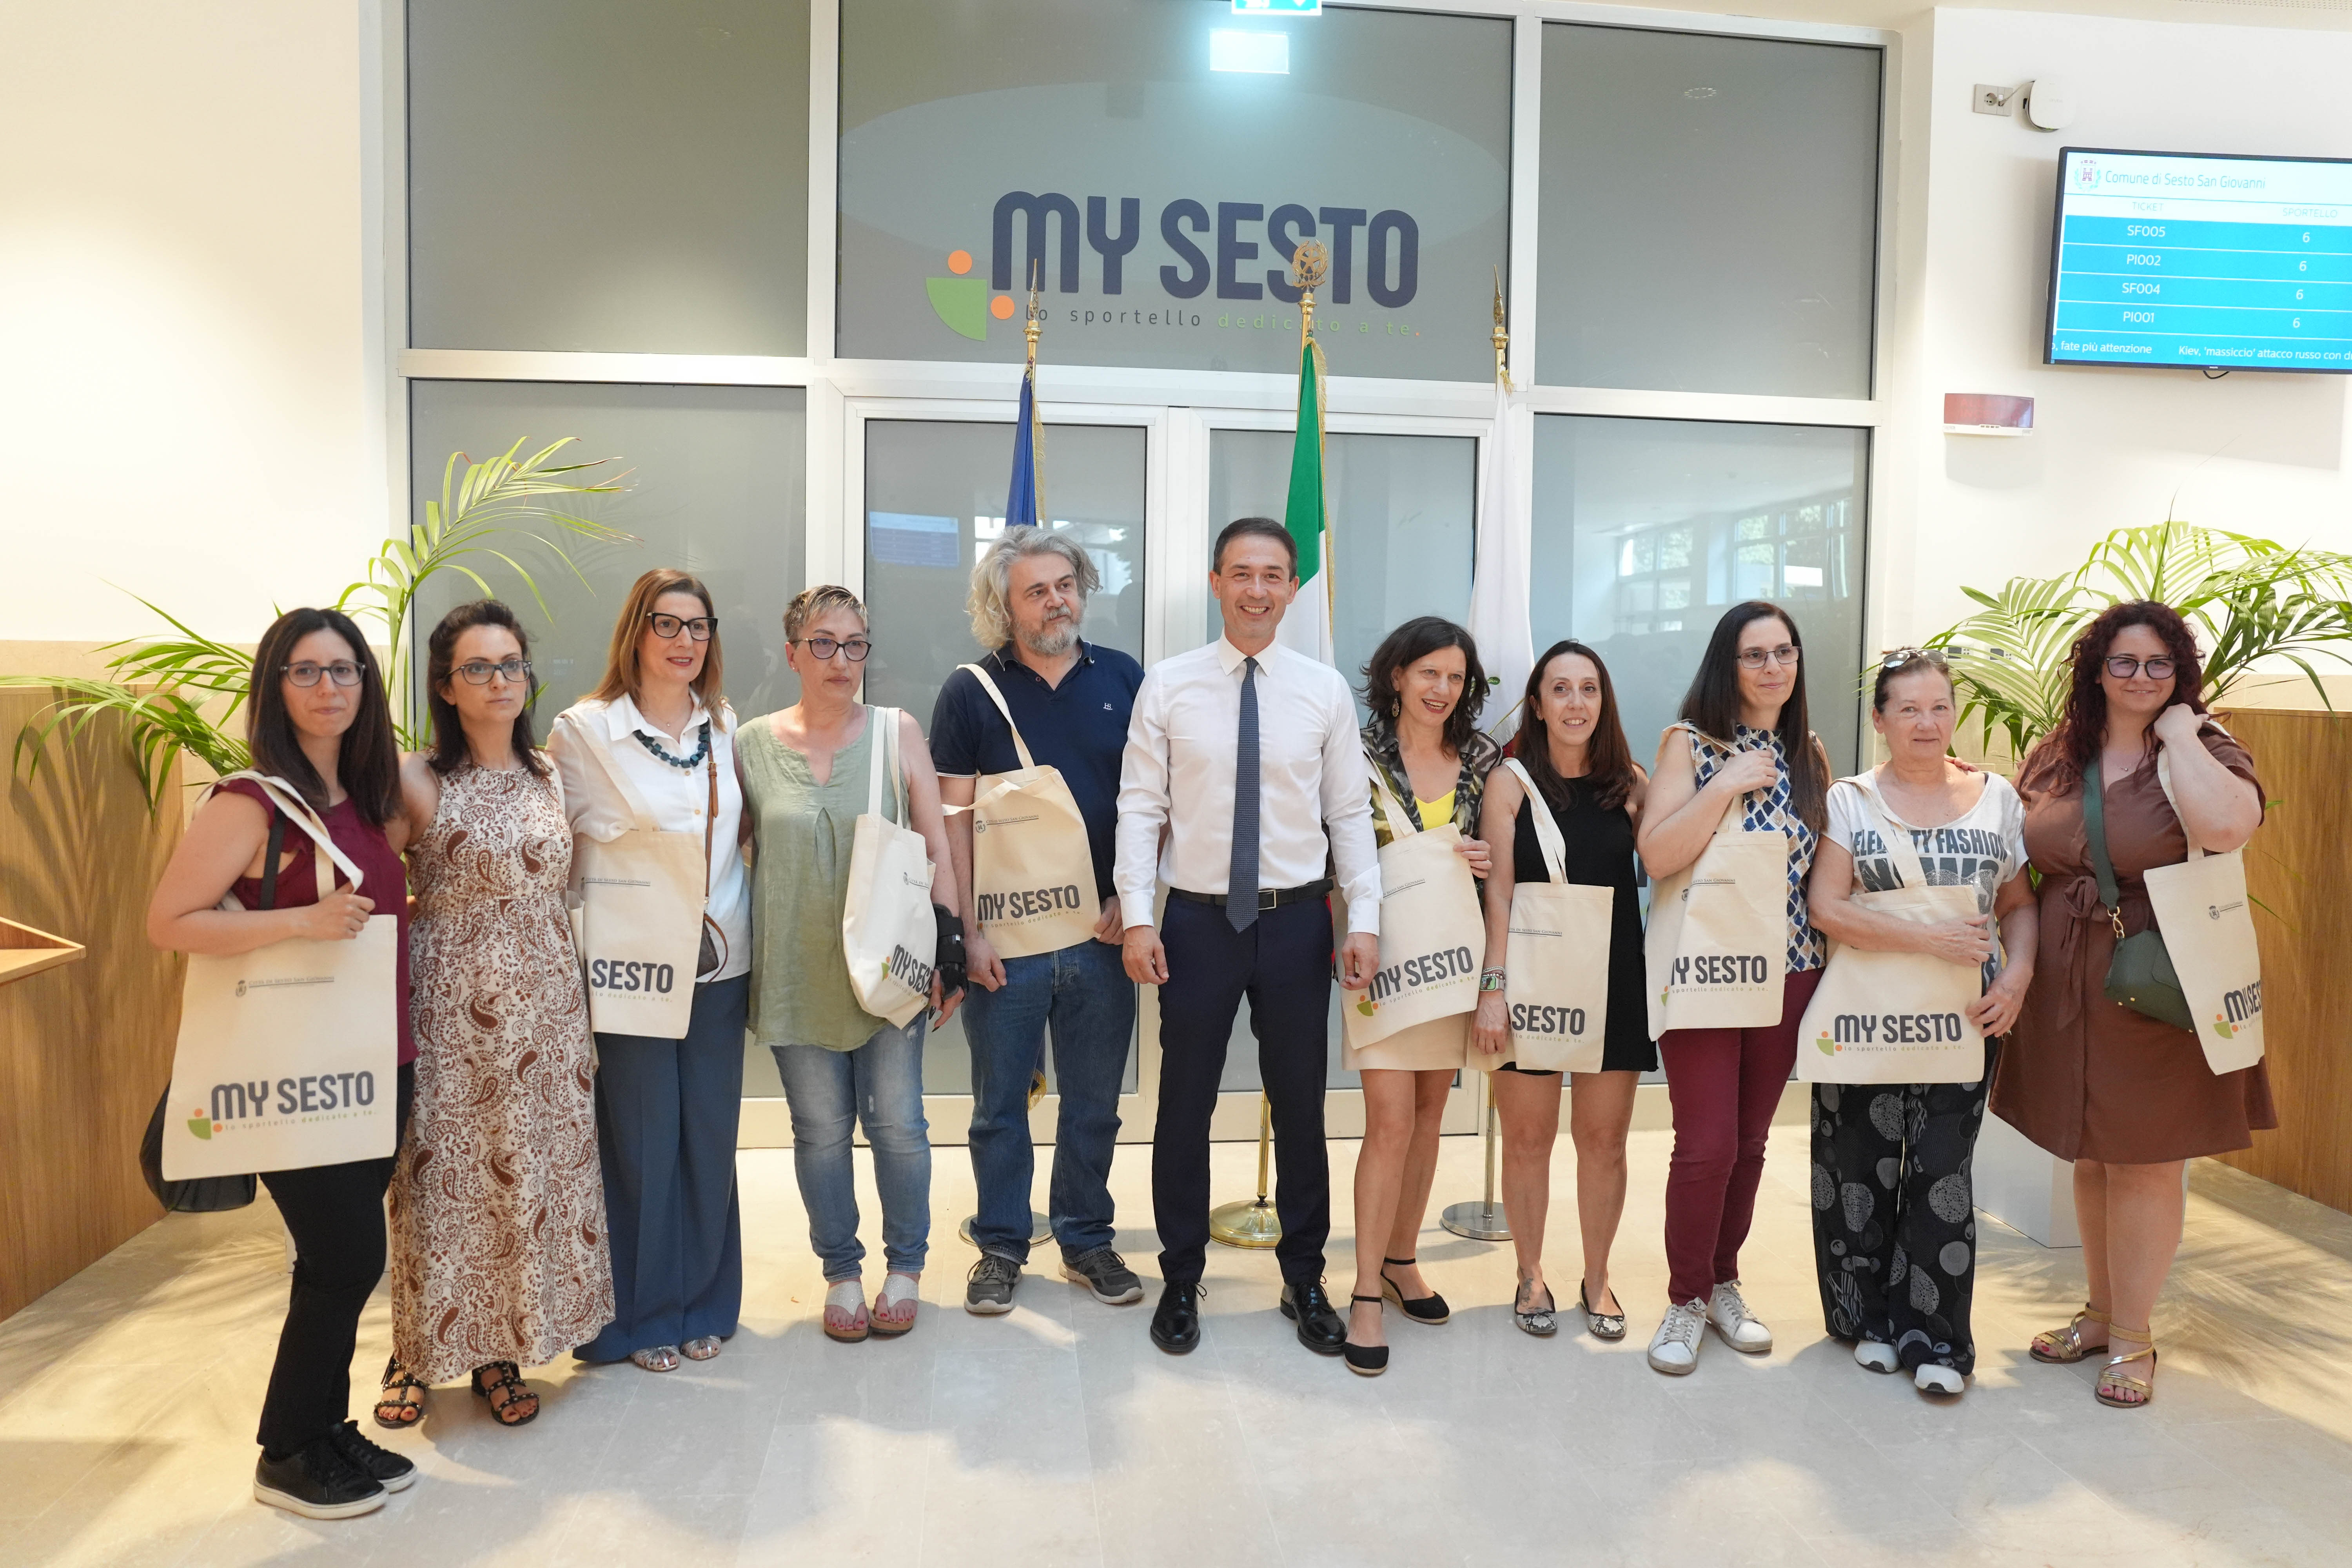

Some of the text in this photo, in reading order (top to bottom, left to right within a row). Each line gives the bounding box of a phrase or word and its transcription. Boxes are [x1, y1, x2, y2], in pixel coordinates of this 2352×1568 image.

[2105, 170, 2266, 189] Comune di Sesto San Giovanni
[2132, 201, 2164, 211] TICKET
[2283, 208, 2337, 218] SPORTELLO
[2127, 225, 2310, 243] SF005 6
[993, 191, 1419, 308] MY SESTO
[2127, 254, 2307, 271] PI002 6
[2122, 283, 2303, 299] SF004 6
[1070, 309, 1200, 326] sportello
[1218, 312, 1340, 332] dedicto
[1359, 322, 1369, 333] a
[2123, 311, 2300, 328] PI001 6
[2061, 341, 2080, 351] fate
[2082, 342, 2098, 353] più
[2100, 343, 2152, 354] attenzione
[2179, 346, 2201, 357] Kiev,
[2204, 347, 2256, 358] 'massiccio'
[2257, 348, 2293, 359] attacco
[2295, 351, 2321, 359] russo
[1935, 829, 2007, 863] FASHION
[978, 885, 1080, 921] MY SESTO
[1028, 911, 1061, 924] dedicato
[889, 944, 912, 980] MY
[1695, 955, 1767, 984] SESTO
[591, 959, 673, 993] SESTO
[1368, 946, 1474, 1002] MY SESTO
[1389, 988, 1423, 1003] sportello
[1426, 980, 1456, 991] dedicato
[1672, 985, 1707, 994] sportello
[1512, 1004, 1585, 1035] SESTO
[1835, 1013, 1962, 1043] MY SESTO
[211, 1071, 374, 1121] MY SESTO
[242, 1118, 295, 1130] sportello
[301, 1113, 347, 1123] dedicato
